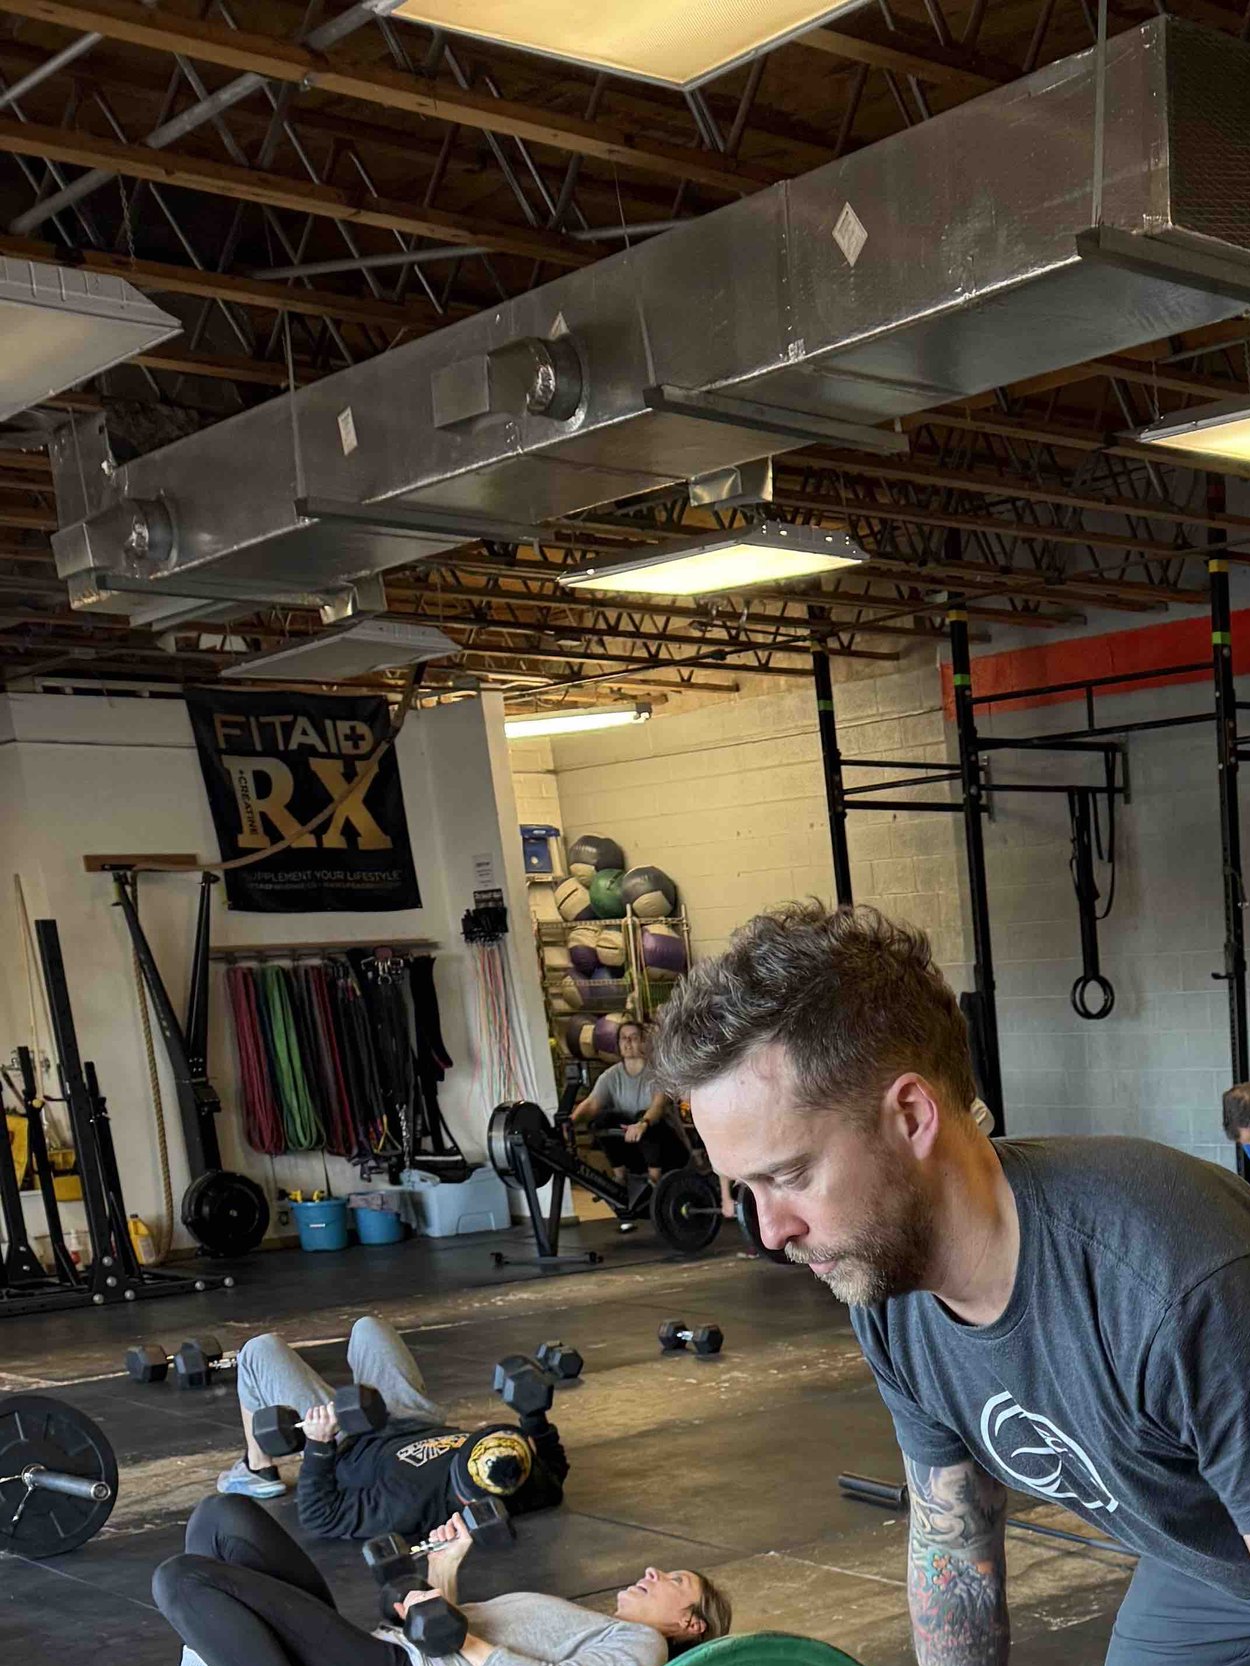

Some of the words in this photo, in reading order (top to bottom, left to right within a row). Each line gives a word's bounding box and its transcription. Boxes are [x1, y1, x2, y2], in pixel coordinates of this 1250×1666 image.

[213, 713, 374, 755] FITAID
[221, 755, 394, 849] RX
[314, 870, 344, 881] YOUR
